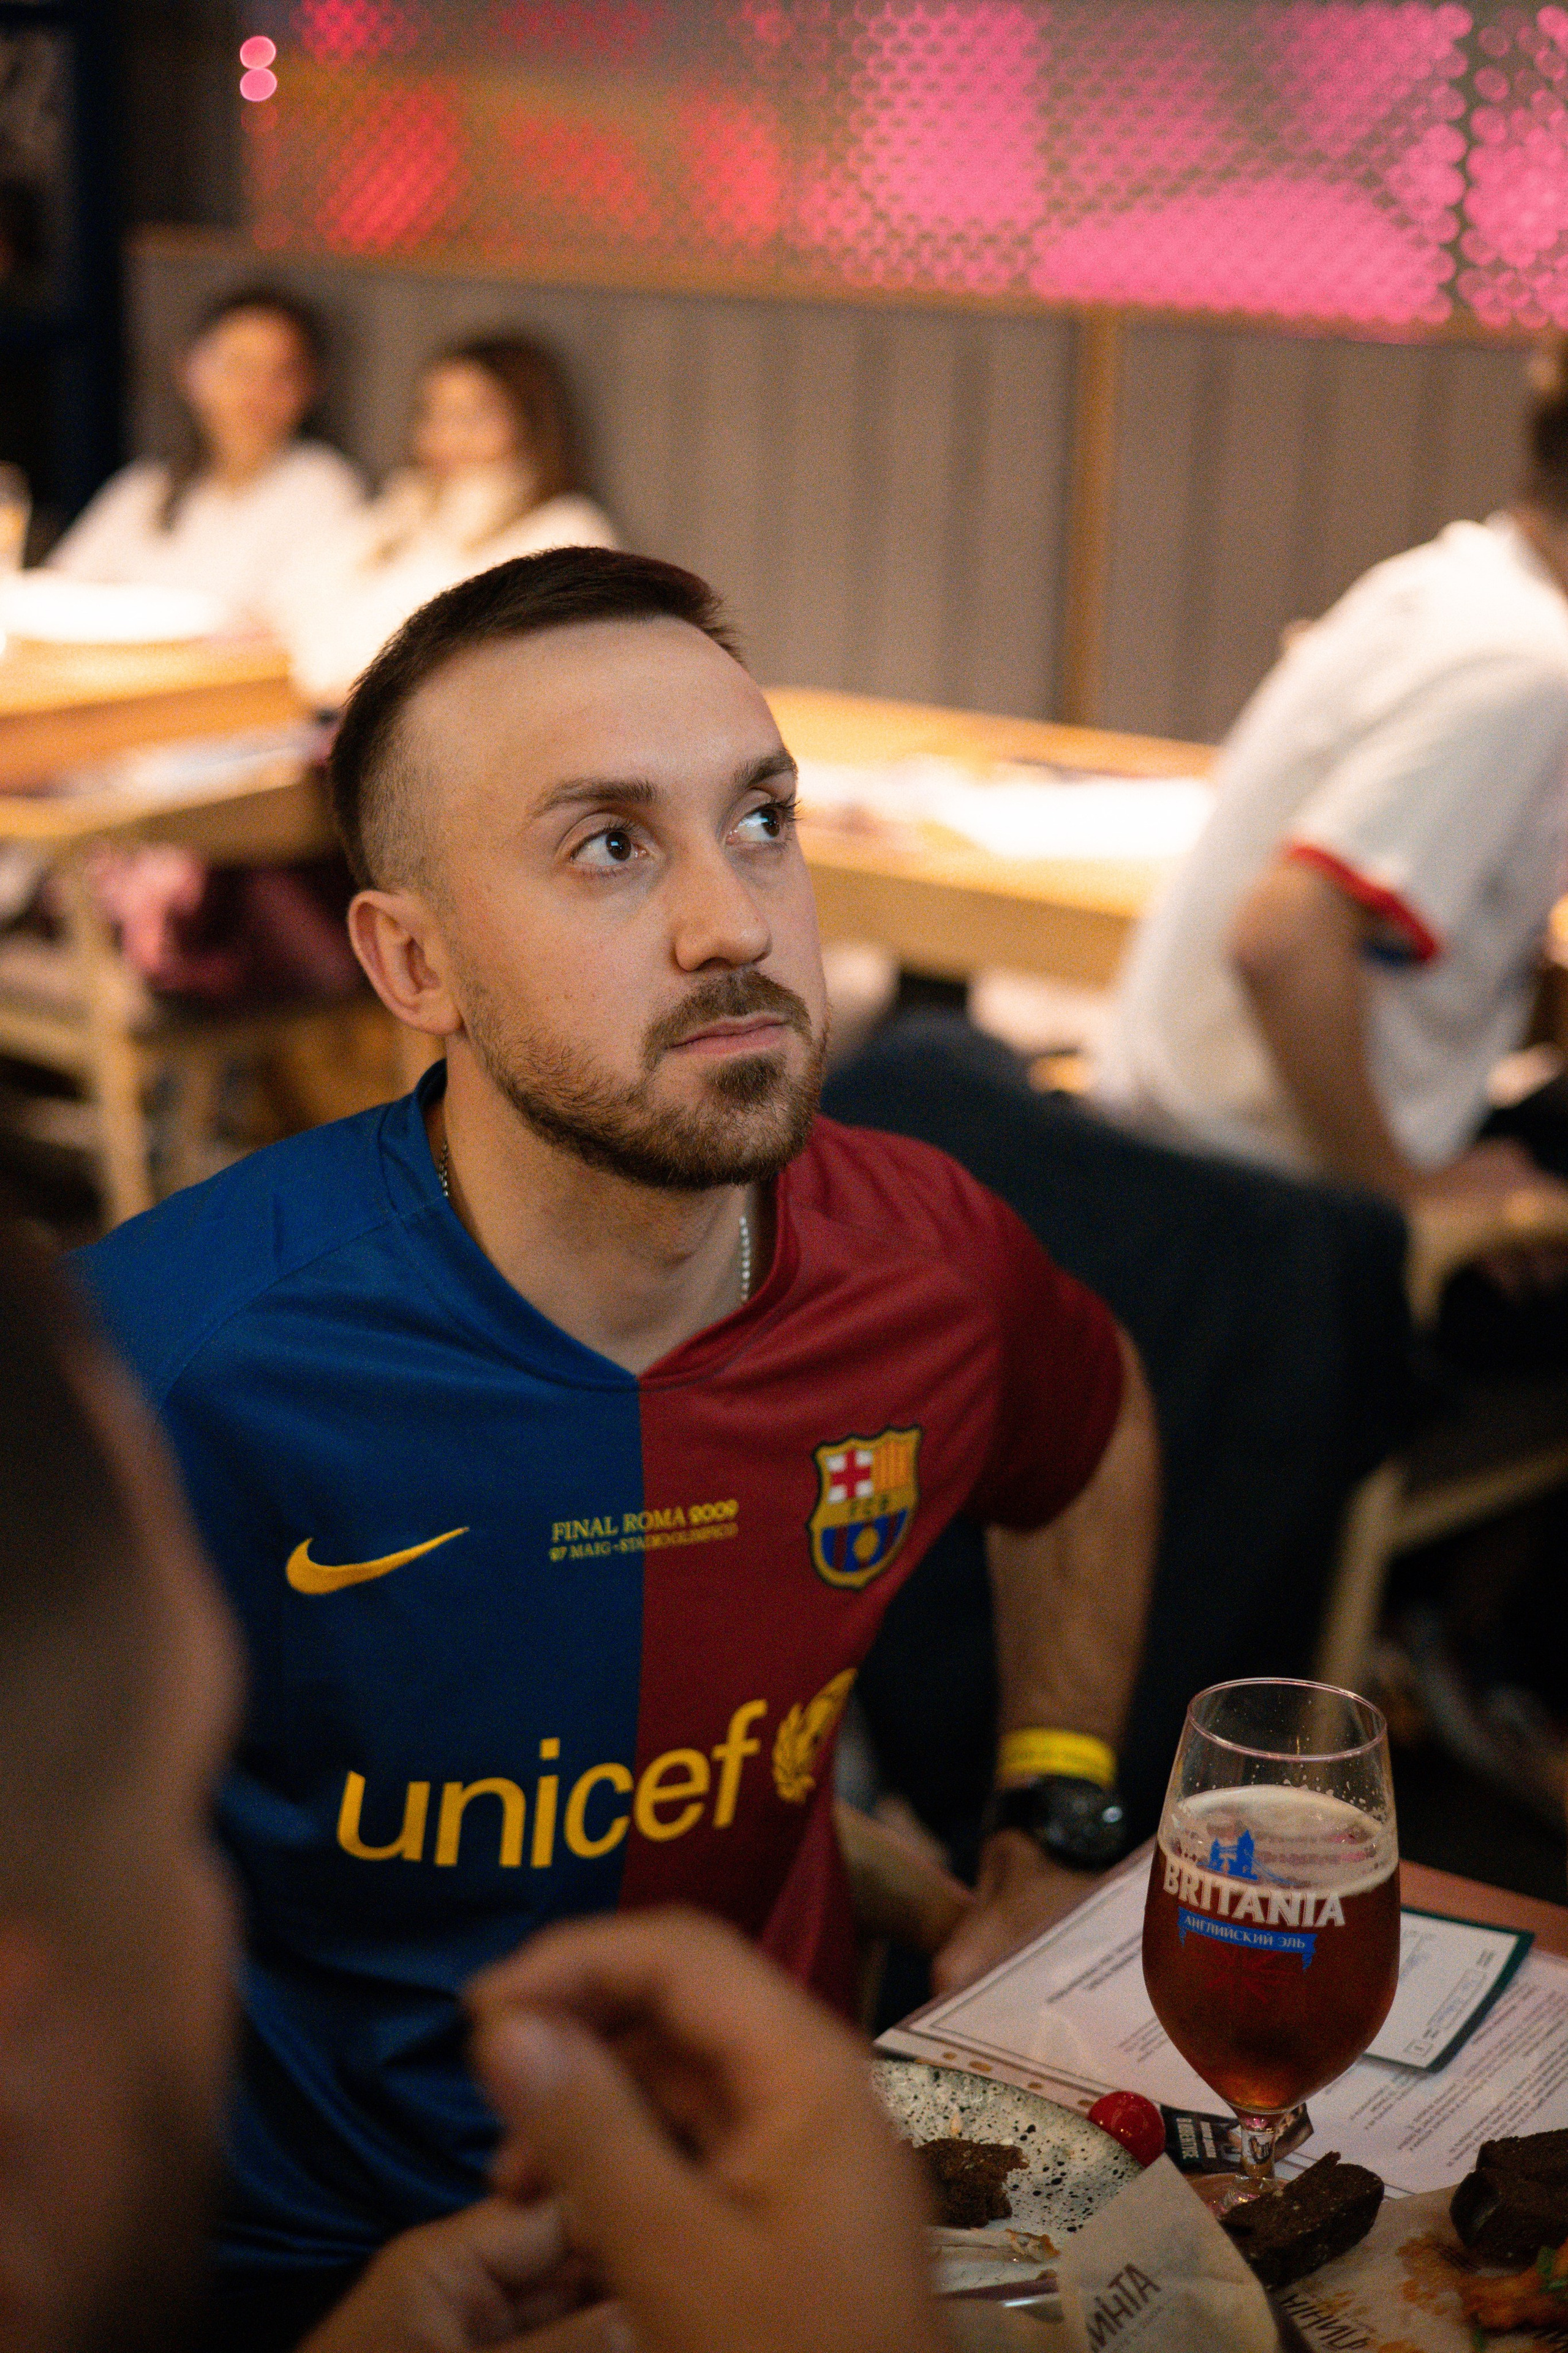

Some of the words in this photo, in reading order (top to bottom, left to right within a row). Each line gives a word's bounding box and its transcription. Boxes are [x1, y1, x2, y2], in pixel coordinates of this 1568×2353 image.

[552, 1517, 619, 1543] FINAL
[622, 1506, 686, 1533] ROMA
[336, 1698, 767, 1868] unicef
[1163, 1863, 1346, 1927] BRITANIA
[1183, 1916, 1273, 1947] АНГЛИЙСКИЙ
[1278, 1935, 1306, 1949] ЭЛЬ
[1085, 2263, 1161, 2353] ИНТА
